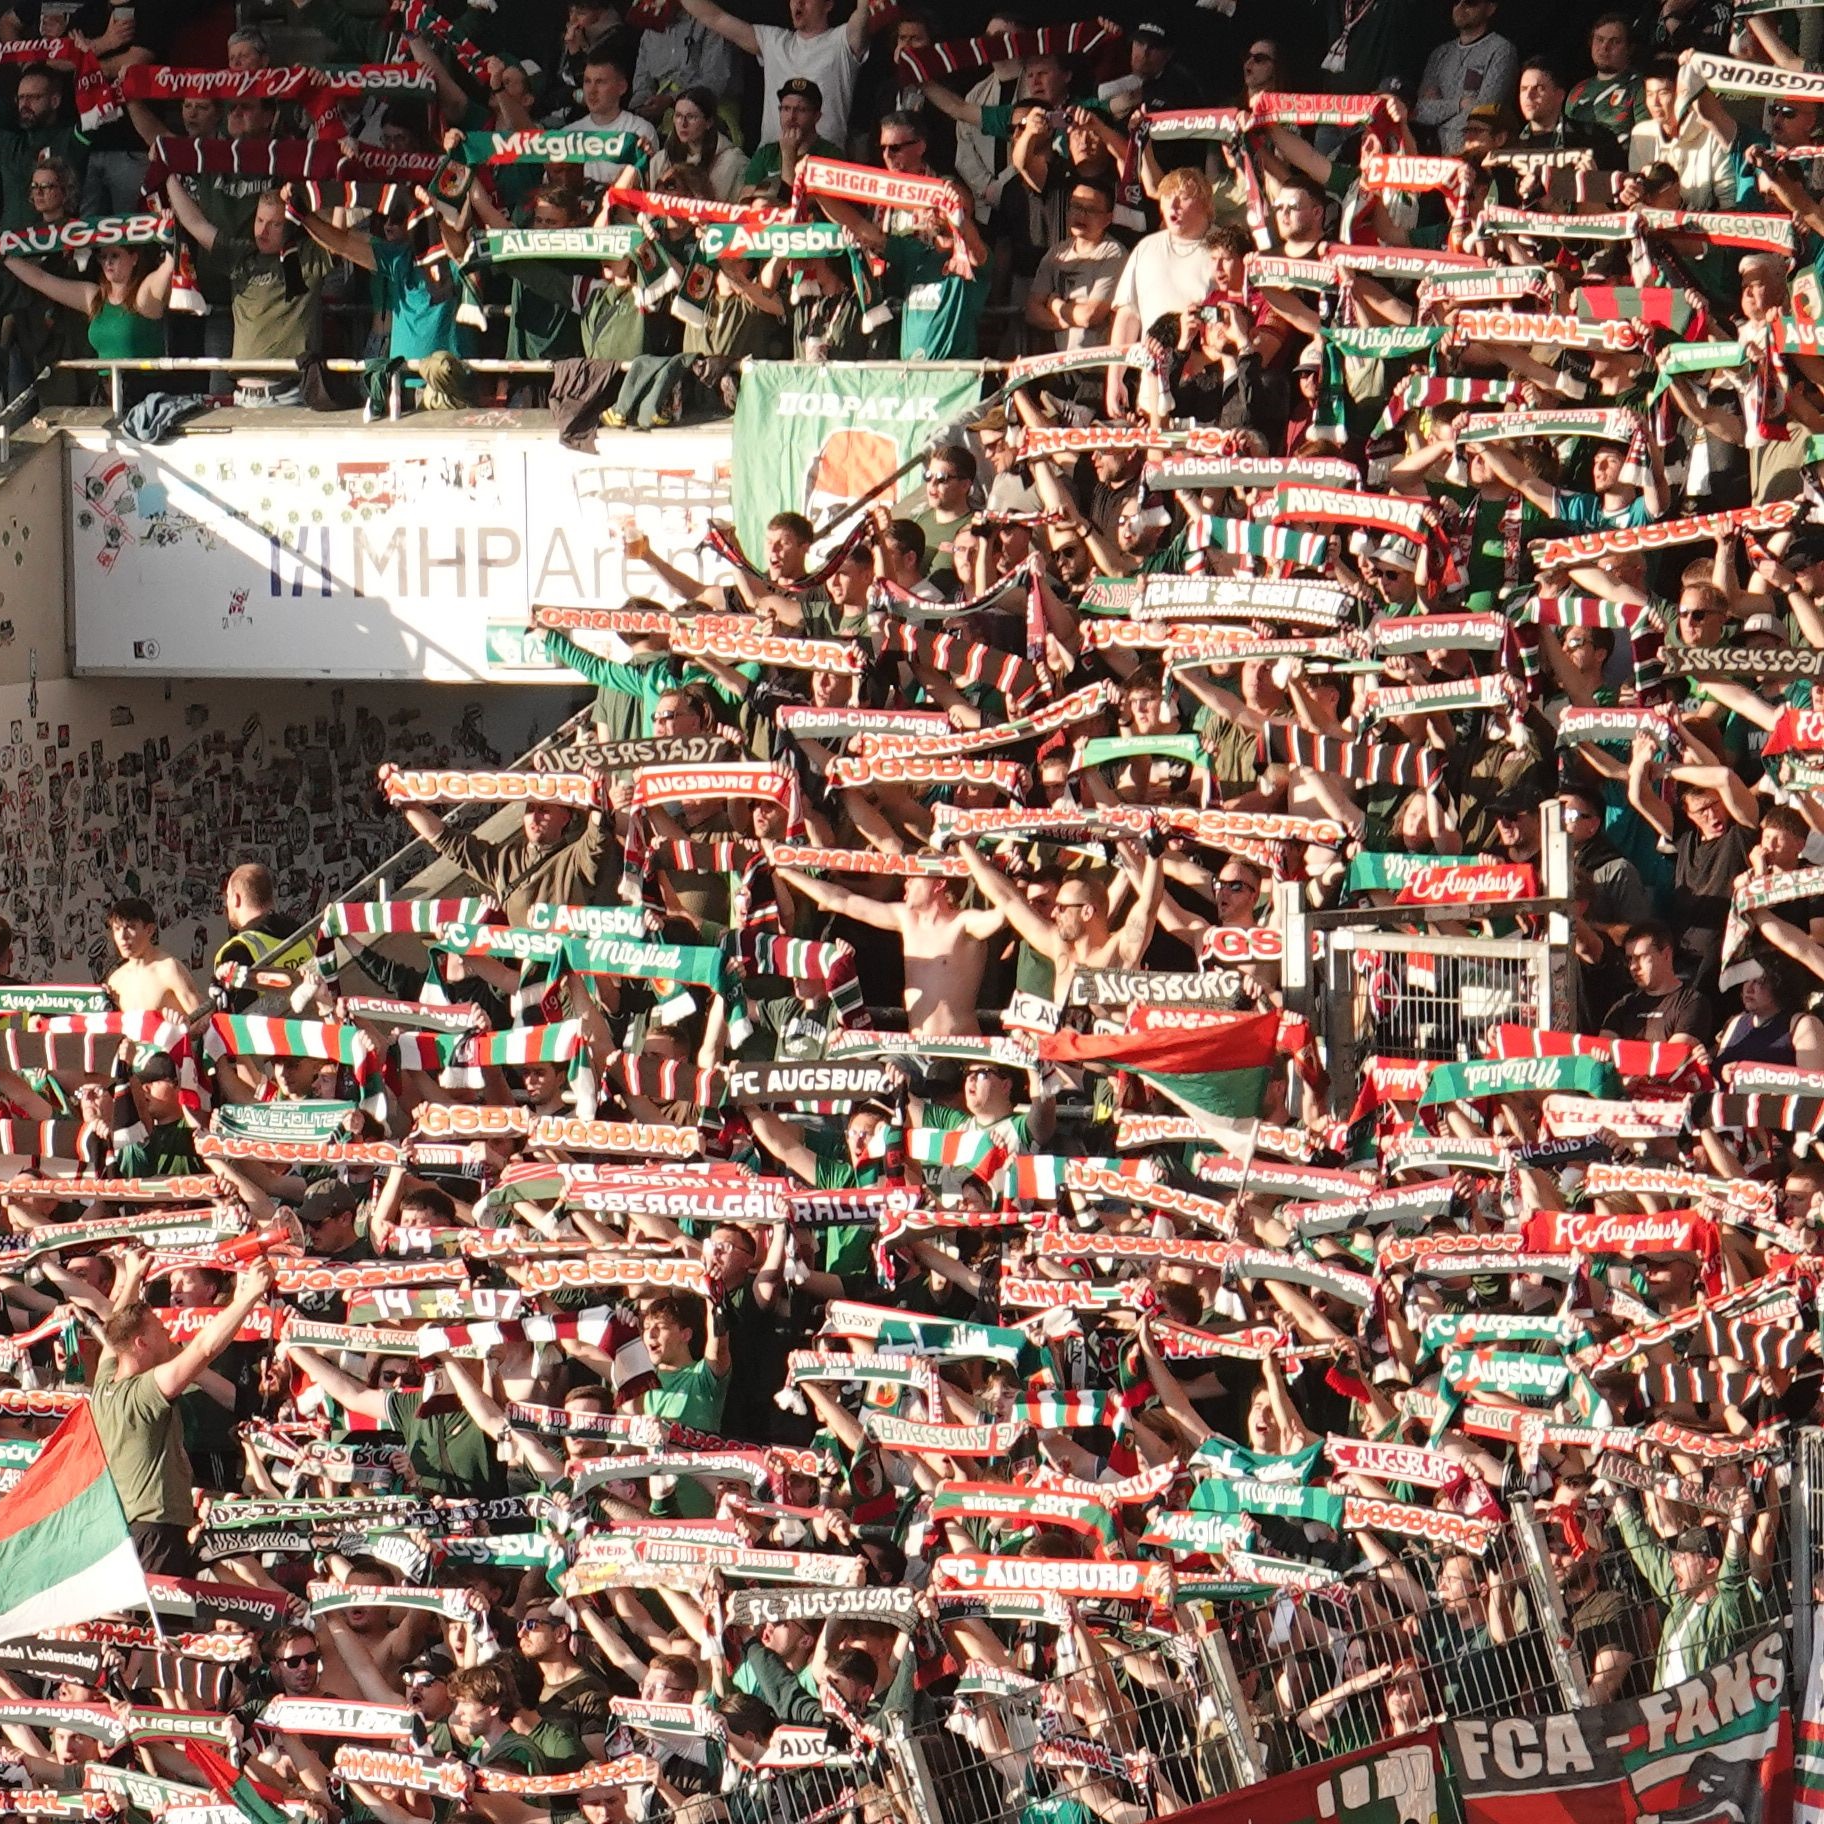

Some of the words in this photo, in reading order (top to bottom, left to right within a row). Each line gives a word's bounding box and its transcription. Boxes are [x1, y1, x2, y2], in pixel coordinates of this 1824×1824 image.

[492, 134, 623, 157] Mitglied
[501, 233, 630, 254] AUGSBURG
[1340, 327, 1430, 351] Mitglied
[1162, 459, 1285, 479] Fußball-Club
[1288, 488, 1422, 521] AUGSBURG
[1544, 504, 1798, 564] AUGSBURG
[354, 526, 521, 598] MHP
[861, 725, 1016, 758] ORIGINAL
[1031, 688, 1101, 725] 1907
[646, 777, 755, 795] AUGSBURG
[773, 847, 925, 872] ORIGINAL
[1443, 867, 1524, 900] Augsburg
[588, 939, 681, 969] Mitglied
[0, 991, 85, 1012] Augsburg
[731, 1071, 760, 1096] FC
[1555, 1213, 1590, 1247] FC
[1591, 1211, 1688, 1250] Augsburg
[1477, 1355, 1568, 1389] Augsburg
[1358, 1450, 1459, 1484] AUGSBURG
[941, 1561, 978, 1587] FC
[984, 1559, 1140, 1593] AUGSBURG
[194, 1589, 277, 1622] Augsburg
[749, 1593, 783, 1627] FC
[786, 1585, 916, 1617] AUGSBURG
[1455, 1712, 1598, 1791] FCA
[1632, 1628, 1789, 1757] FANS
